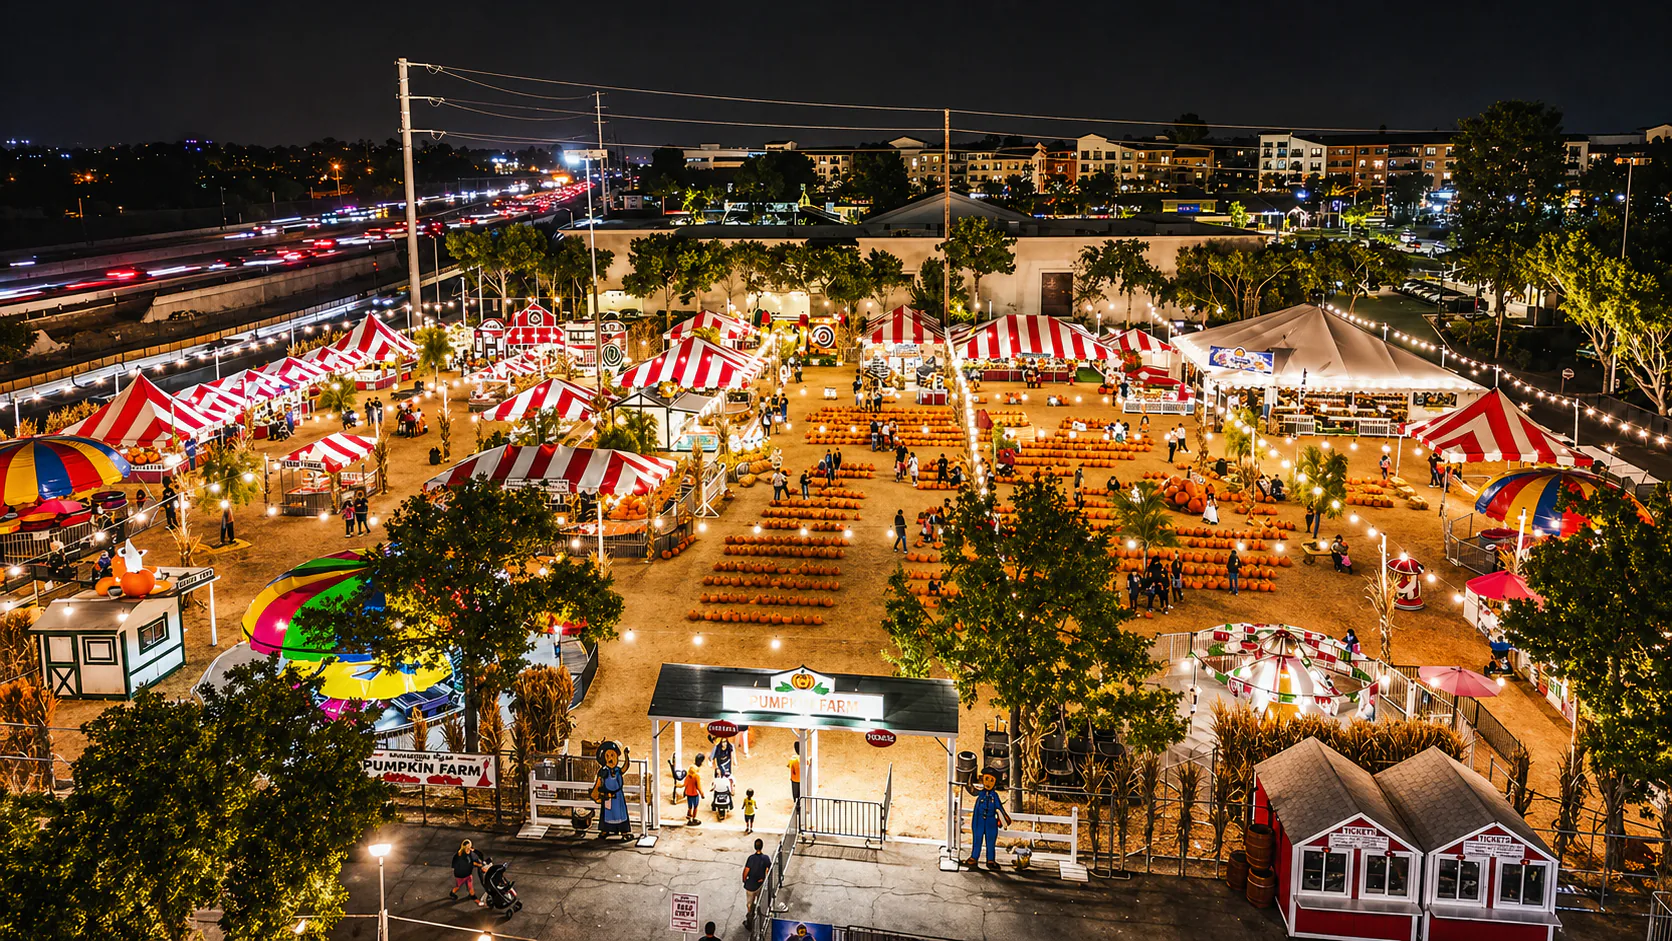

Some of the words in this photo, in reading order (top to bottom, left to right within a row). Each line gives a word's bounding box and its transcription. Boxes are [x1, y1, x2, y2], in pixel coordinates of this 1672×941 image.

[749, 695, 815, 709] PUMPK
[819, 699, 859, 714] FARM
[363, 760, 434, 774] PUMPKIN
[439, 763, 481, 776] FARM
